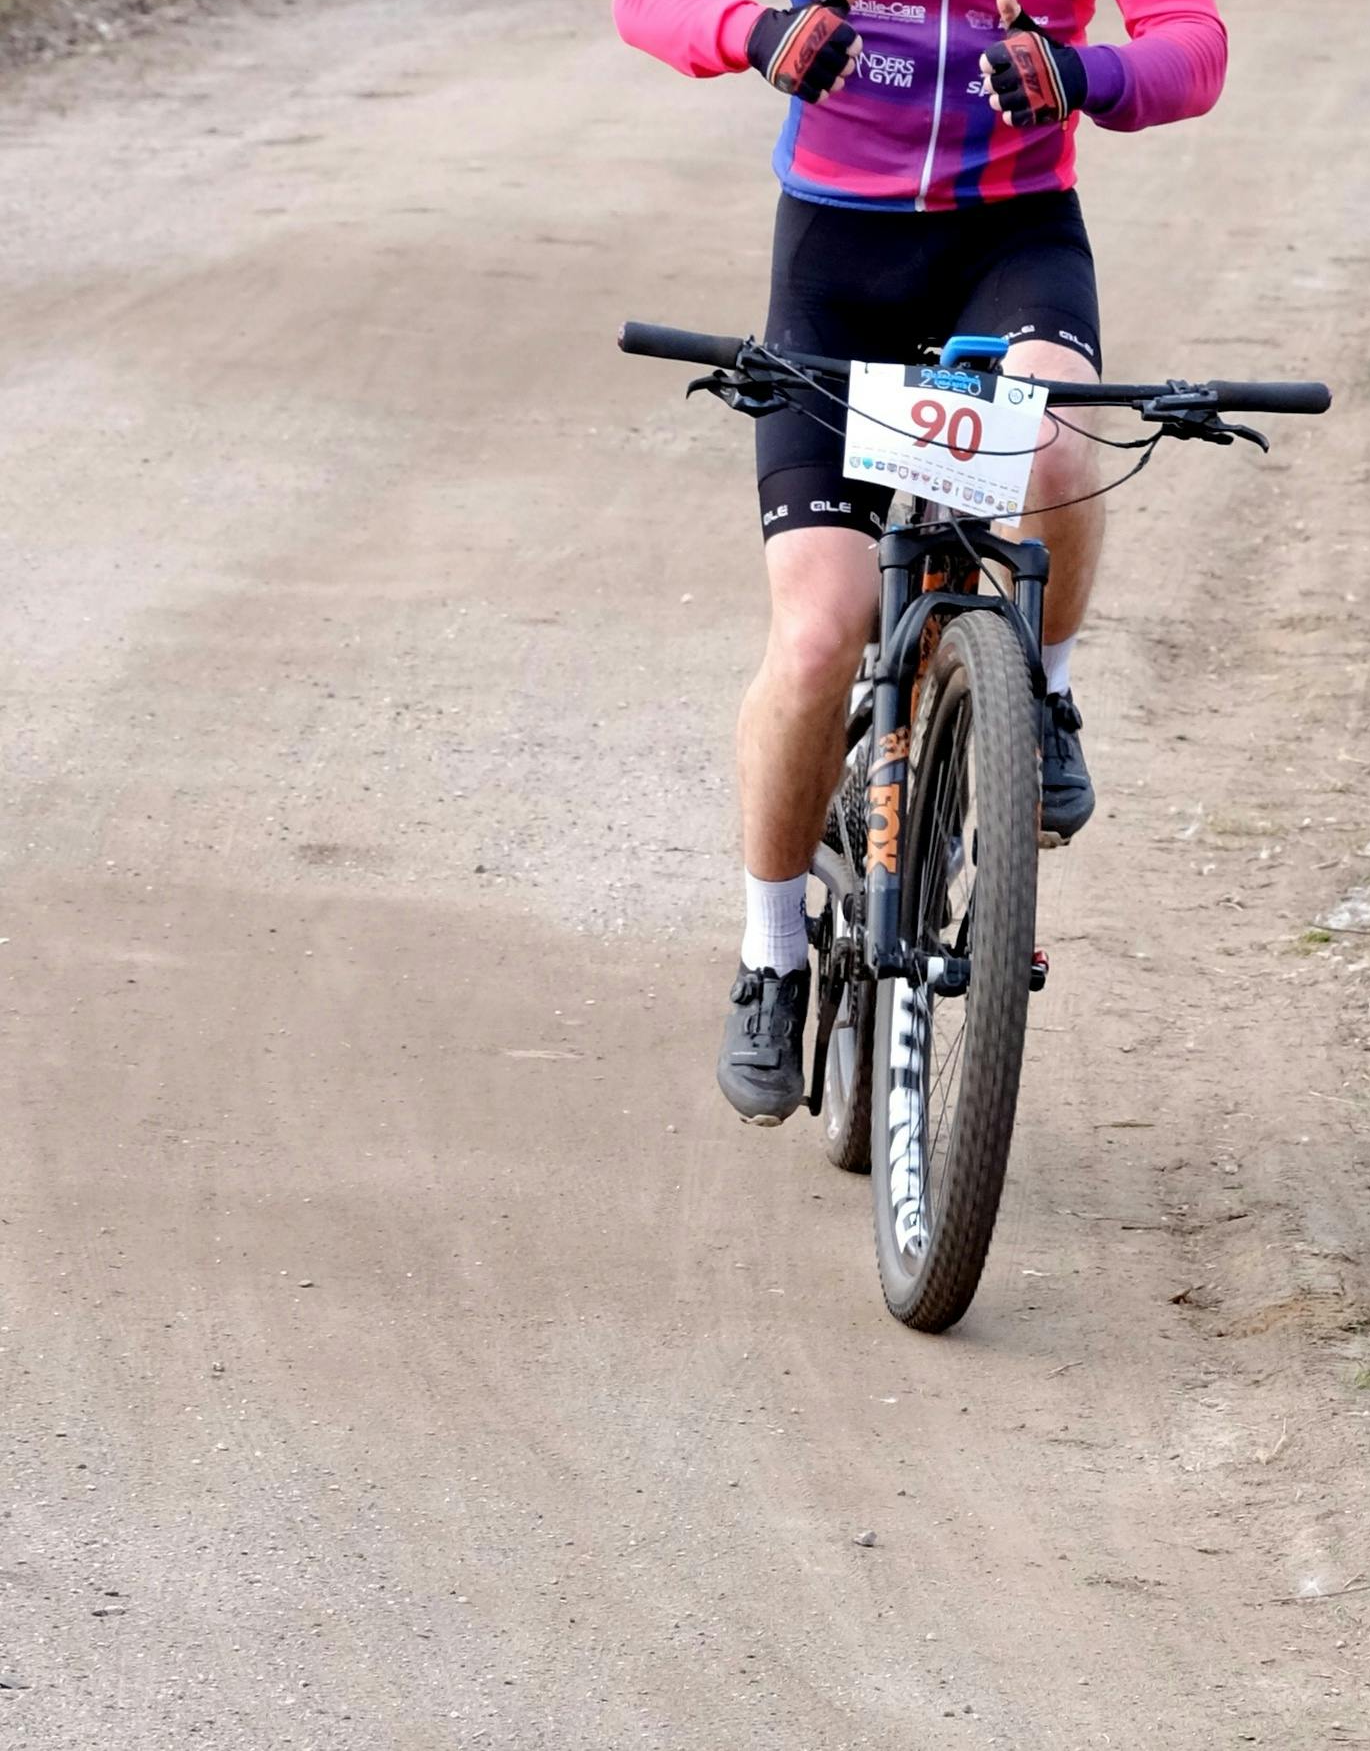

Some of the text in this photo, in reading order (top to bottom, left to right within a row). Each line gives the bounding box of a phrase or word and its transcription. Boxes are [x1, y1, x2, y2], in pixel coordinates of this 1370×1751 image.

[870, 69, 912, 88] GYM
[911, 399, 982, 462] 90
[867, 784, 900, 873] FOX
